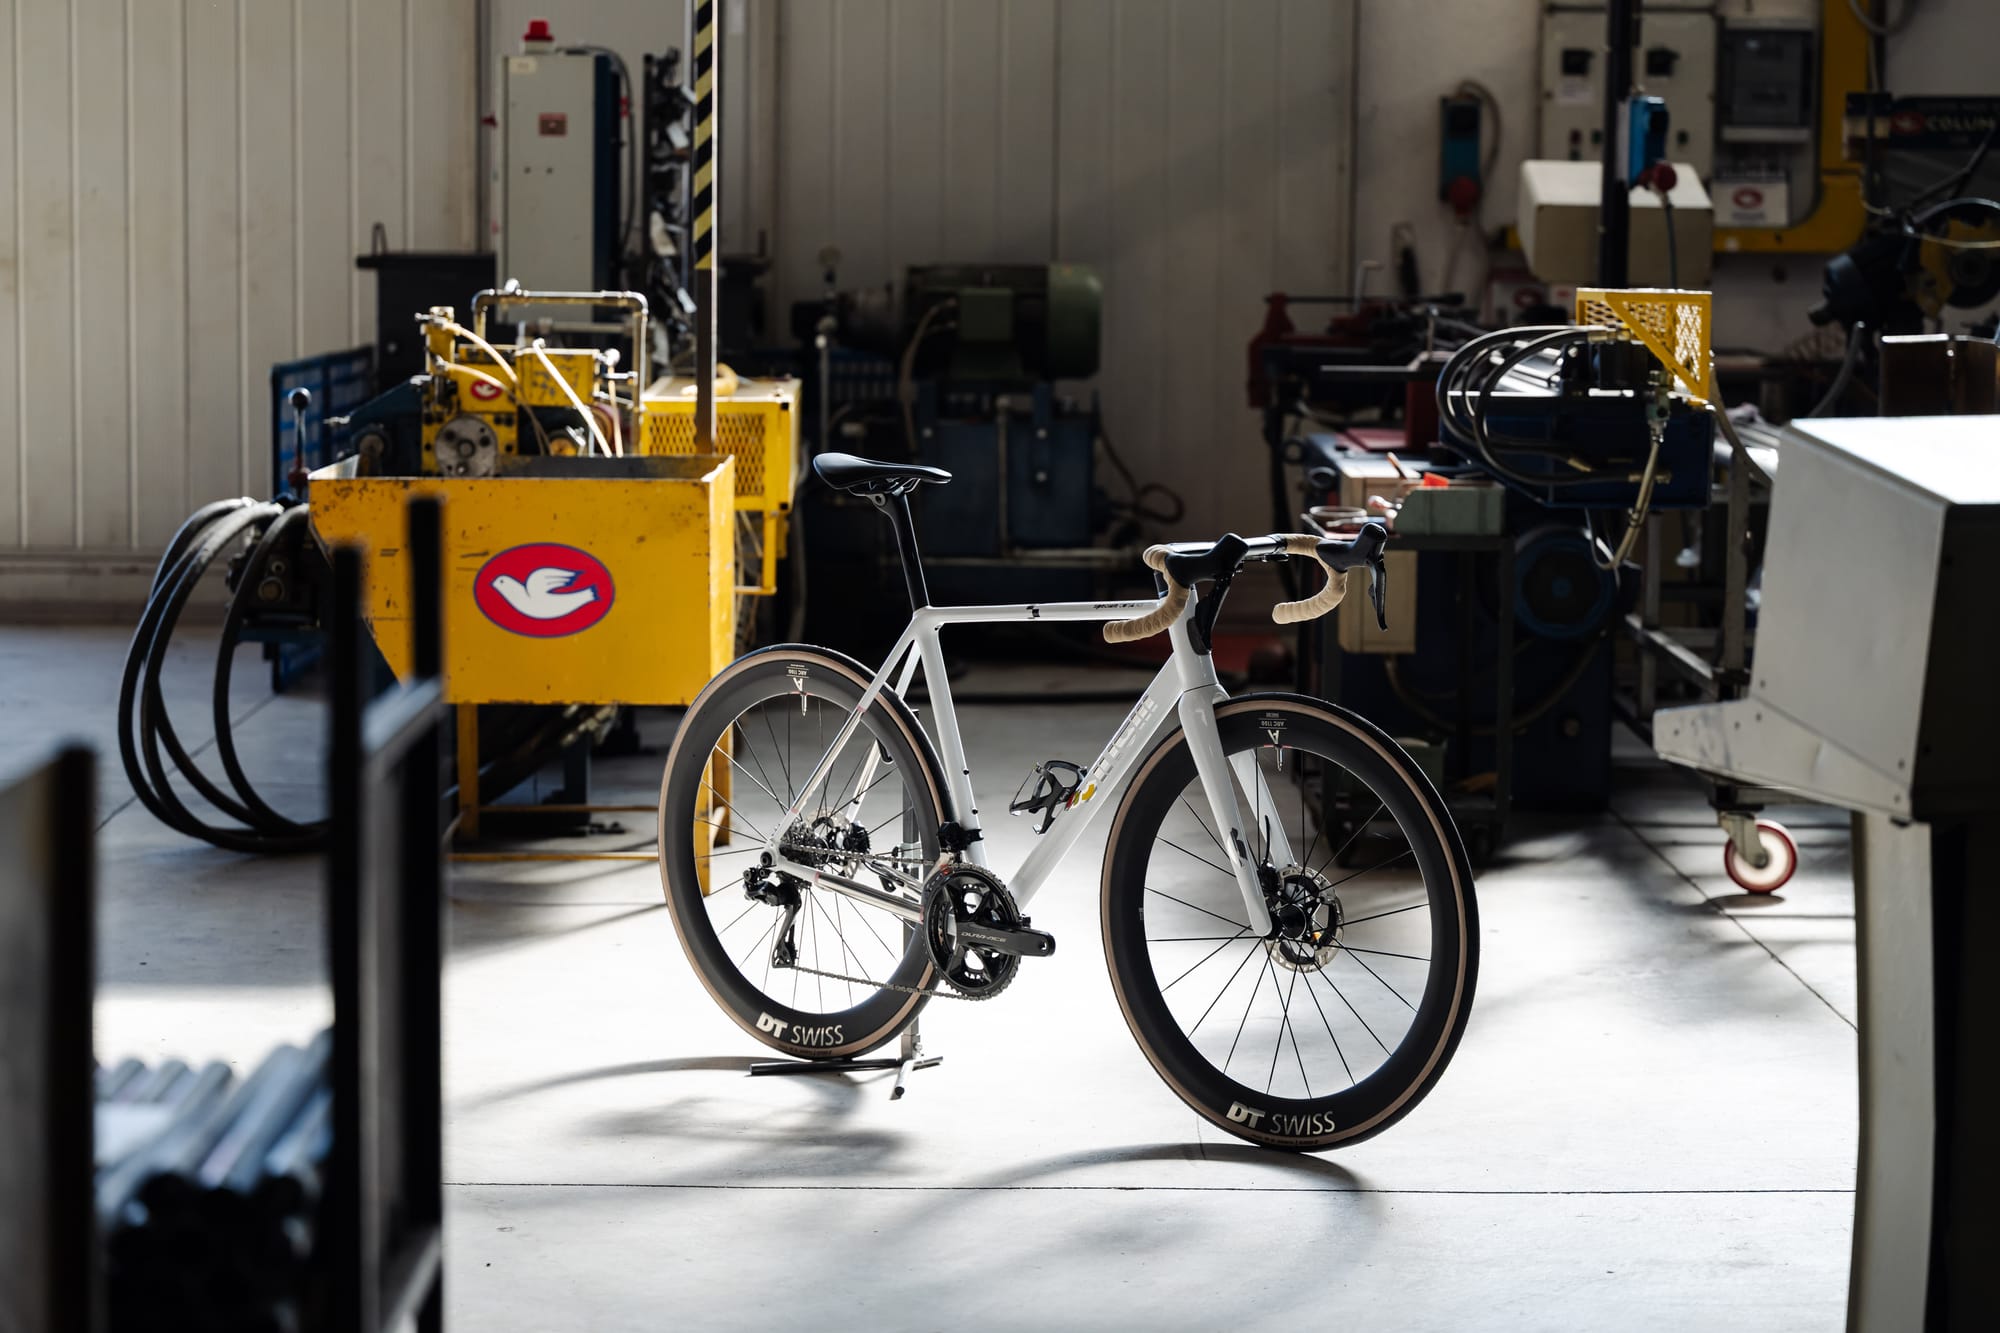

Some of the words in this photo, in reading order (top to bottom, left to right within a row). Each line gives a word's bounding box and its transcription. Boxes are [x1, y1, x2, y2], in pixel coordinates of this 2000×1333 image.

[755, 1011, 789, 1039] DT
[790, 1024, 845, 1047] SWISS
[1225, 1101, 1266, 1129] DT
[1269, 1110, 1336, 1136] SWISS
